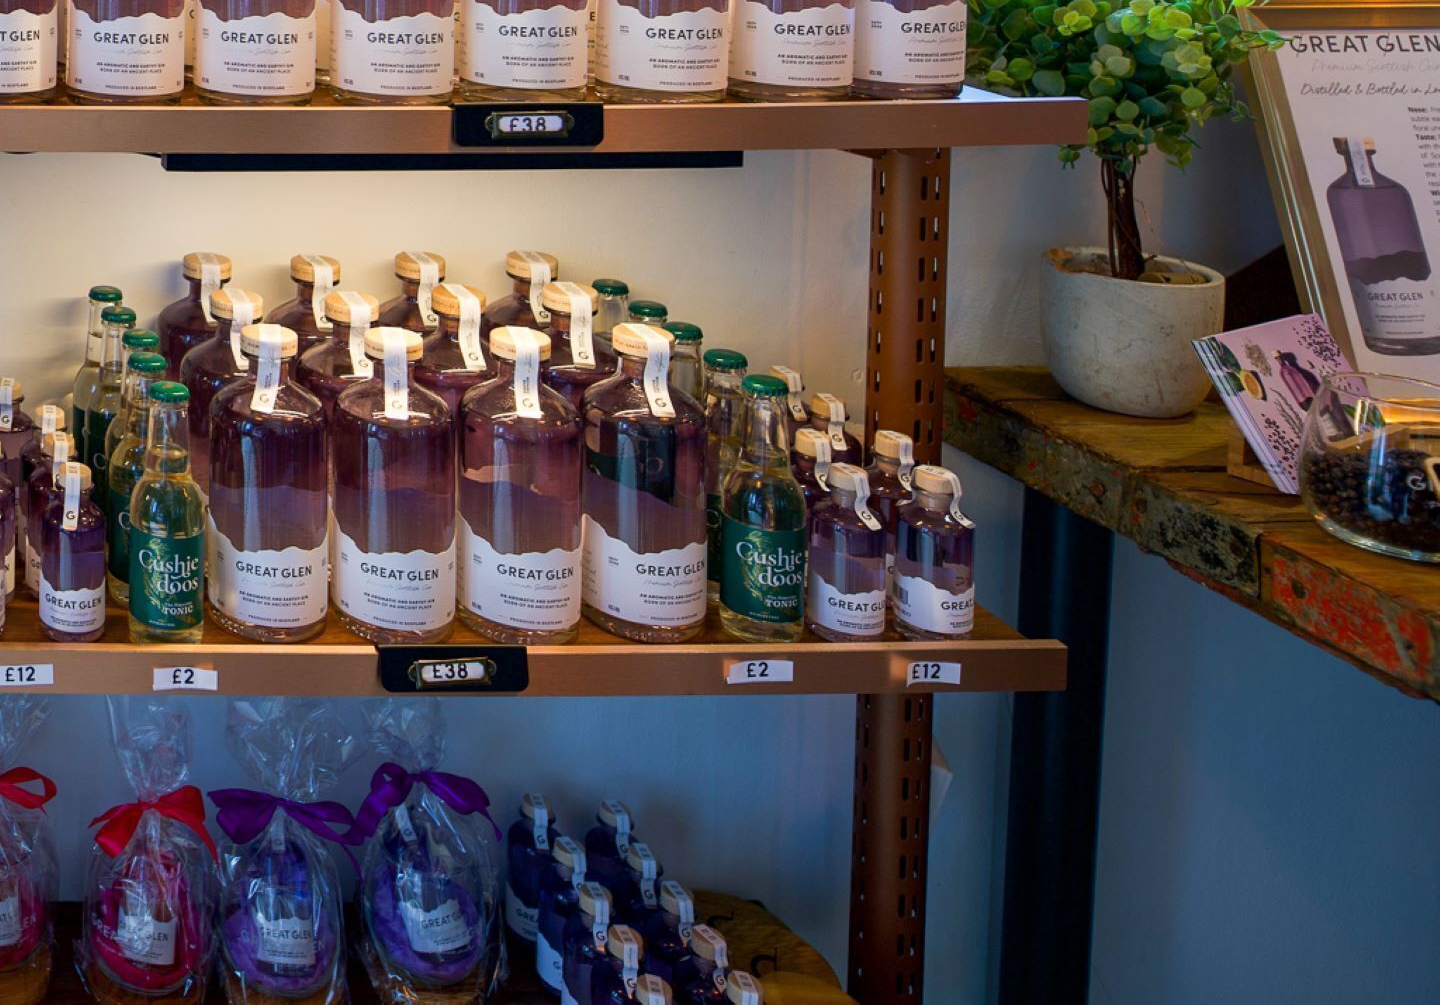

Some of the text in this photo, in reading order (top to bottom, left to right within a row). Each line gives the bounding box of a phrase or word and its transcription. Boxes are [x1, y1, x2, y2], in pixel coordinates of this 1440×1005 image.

[9, 29, 41, 42] GLEN
[498, 25, 578, 38] GREAT GLEN
[646, 27, 724, 40] GREAT GLEN
[774, 23, 852, 36] GREAT GLEN
[901, 21, 947, 34] GREAT
[93, 32, 169, 45] GREAT GLEN
[220, 31, 298, 45] GREAT GLEN
[367, 31, 444, 45] GREAT GLEN
[1289, 33, 1440, 55] GREAT GLEN
[1300, 82, 1353, 96] Distilled
[1366, 82, 1408, 96] Bottled
[1410, 86, 1420, 95] in
[509, 116, 547, 132] £38
[1367, 291, 1423, 302] GREAT GLEN
[138, 549, 199, 577] Cushie
[736, 541, 802, 574] Cushie
[235, 560, 313, 578] GREAT GLEN
[360, 562, 440, 582] GREAT GLEN
[496, 563, 574, 581] GREAT GLEN
[636, 559, 705, 577] GREAT GLEN
[156, 573, 199, 595] doos
[759, 569, 802, 588] doos
[45, 593, 102, 610] GREAT GLEN
[765, 598, 798, 608] TONIC
[828, 596, 870, 612] GREAT
[5, 666, 36, 682] £12
[172, 668, 195, 685] £2
[432, 663, 469, 679] £38
[746, 662, 769, 678] £2
[911, 663, 941, 679] £12
